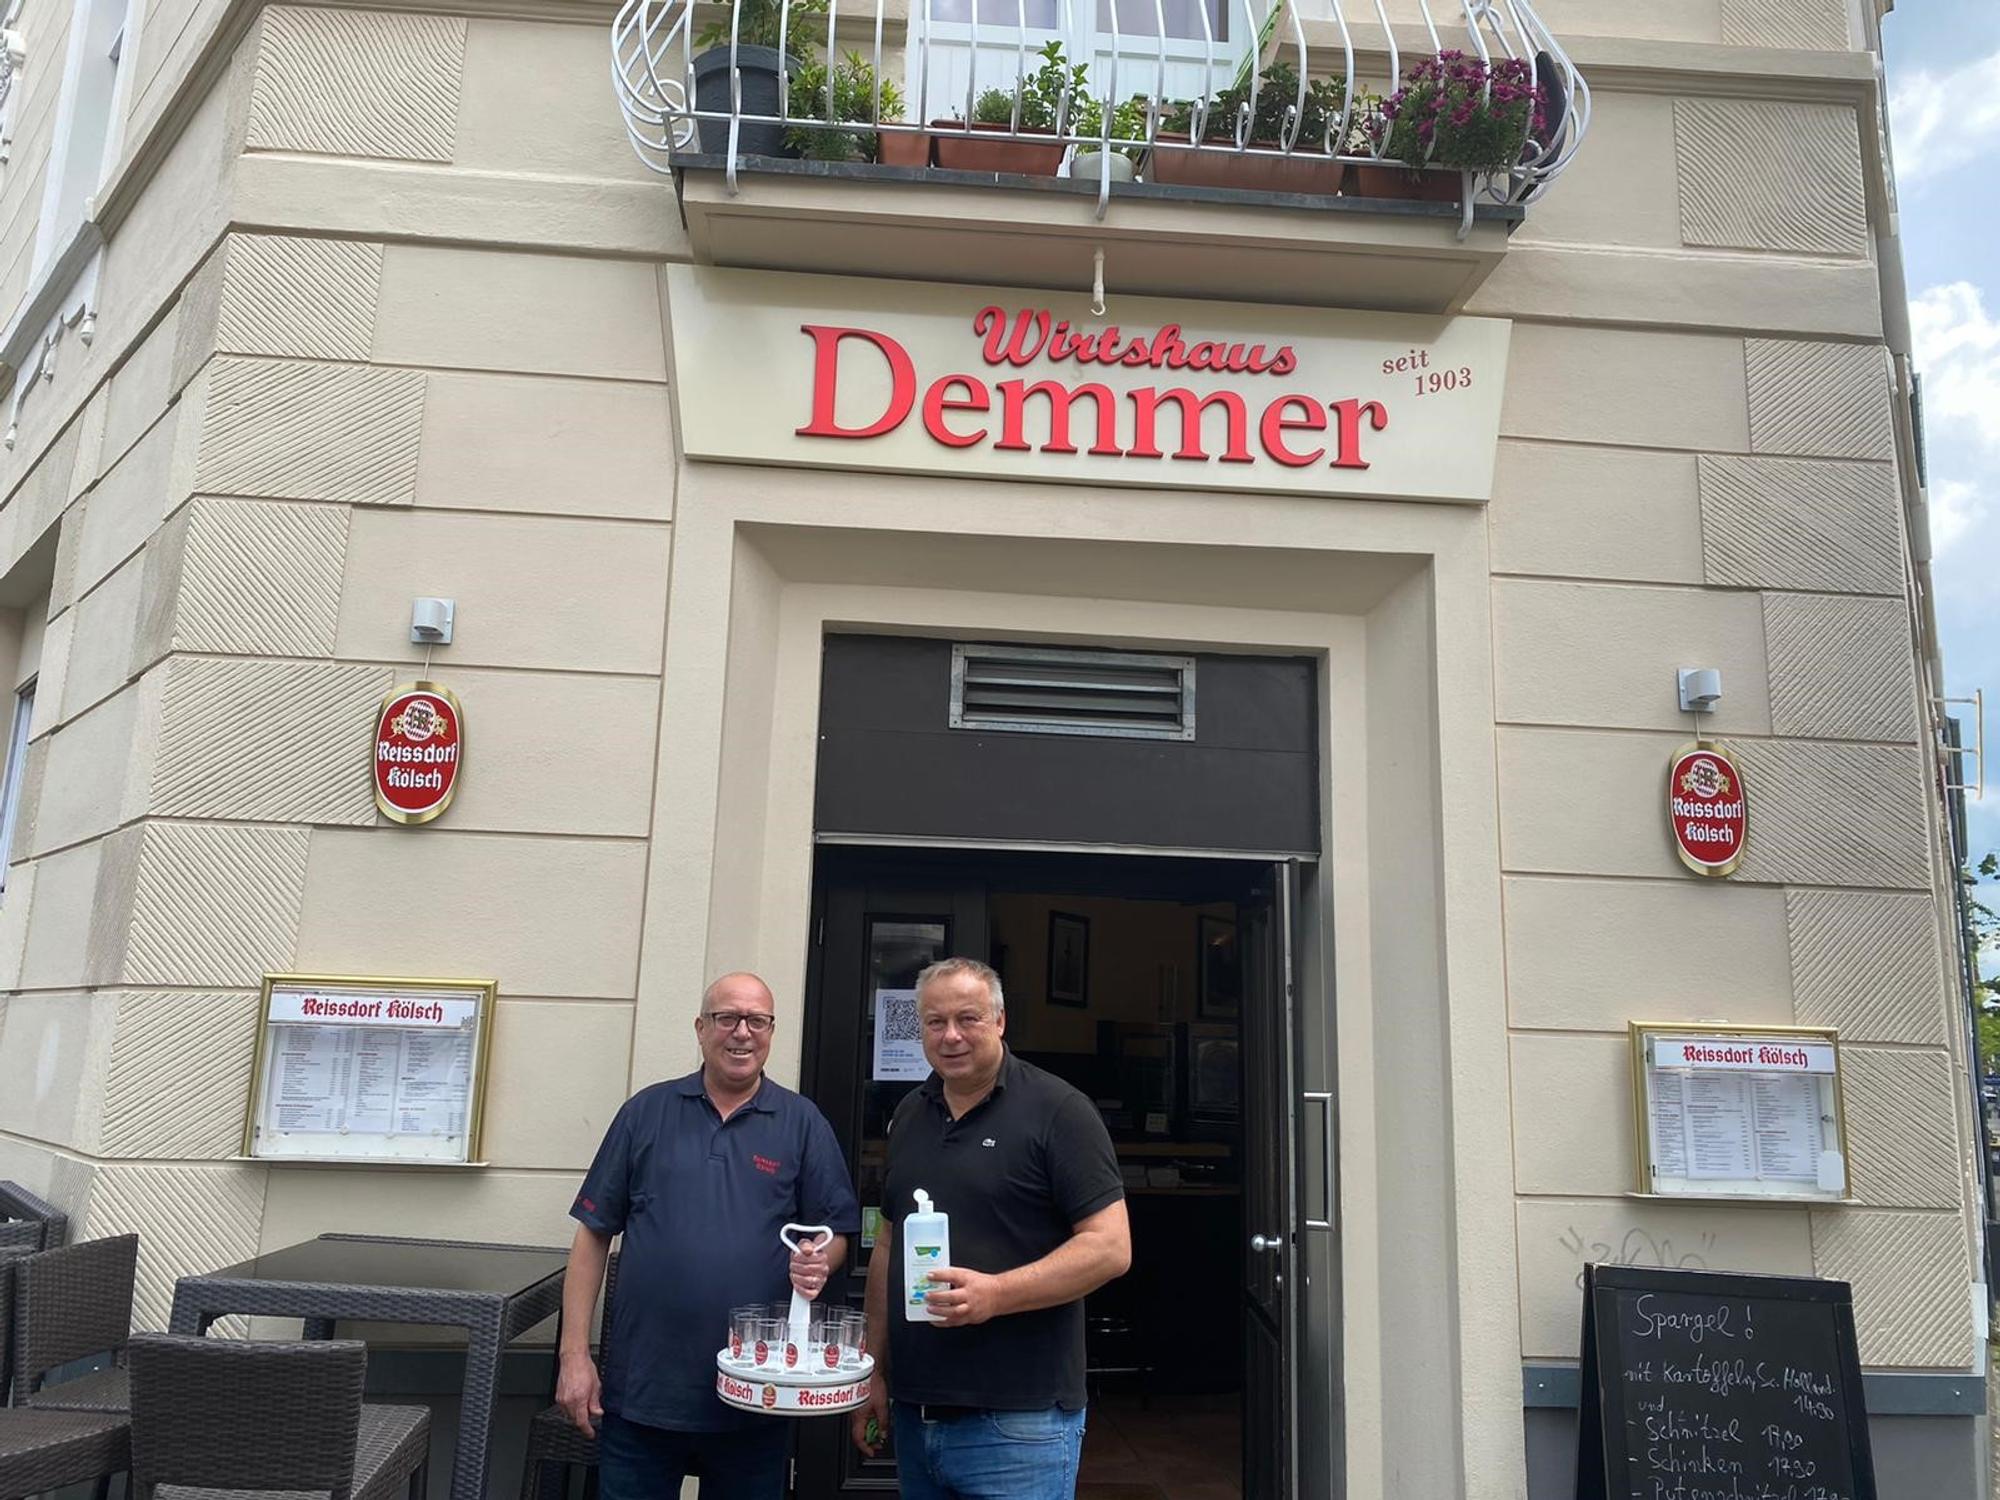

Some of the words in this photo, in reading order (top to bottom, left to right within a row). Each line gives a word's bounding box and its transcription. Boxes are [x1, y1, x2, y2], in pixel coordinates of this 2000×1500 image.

[974, 305, 1298, 376] Wirtshaus
[1382, 349, 1430, 374] seit
[1415, 367, 1472, 396] 1903
[795, 324, 1388, 470] Demmer
[378, 741, 457, 763] Reissdorf
[387, 766, 442, 791] Kölsch
[1673, 797, 1742, 819] Reissdorf
[1685, 821, 1734, 845] Kölsch
[302, 998, 383, 1018] Reissdorf
[386, 999, 443, 1023] Kölsch
[1683, 1045, 1753, 1064] Reissdorf
[1758, 1046, 1808, 1068] Kölsch
[1632, 1294, 1735, 1342] Spargel
[1624, 1361, 1652, 1382] mit
[797, 1384, 854, 1406] Reissdorf
[1638, 1395, 1665, 1412] und
[1645, 1410, 1744, 1444] Schnitzel
[1648, 1443, 1744, 1473] Schinken
